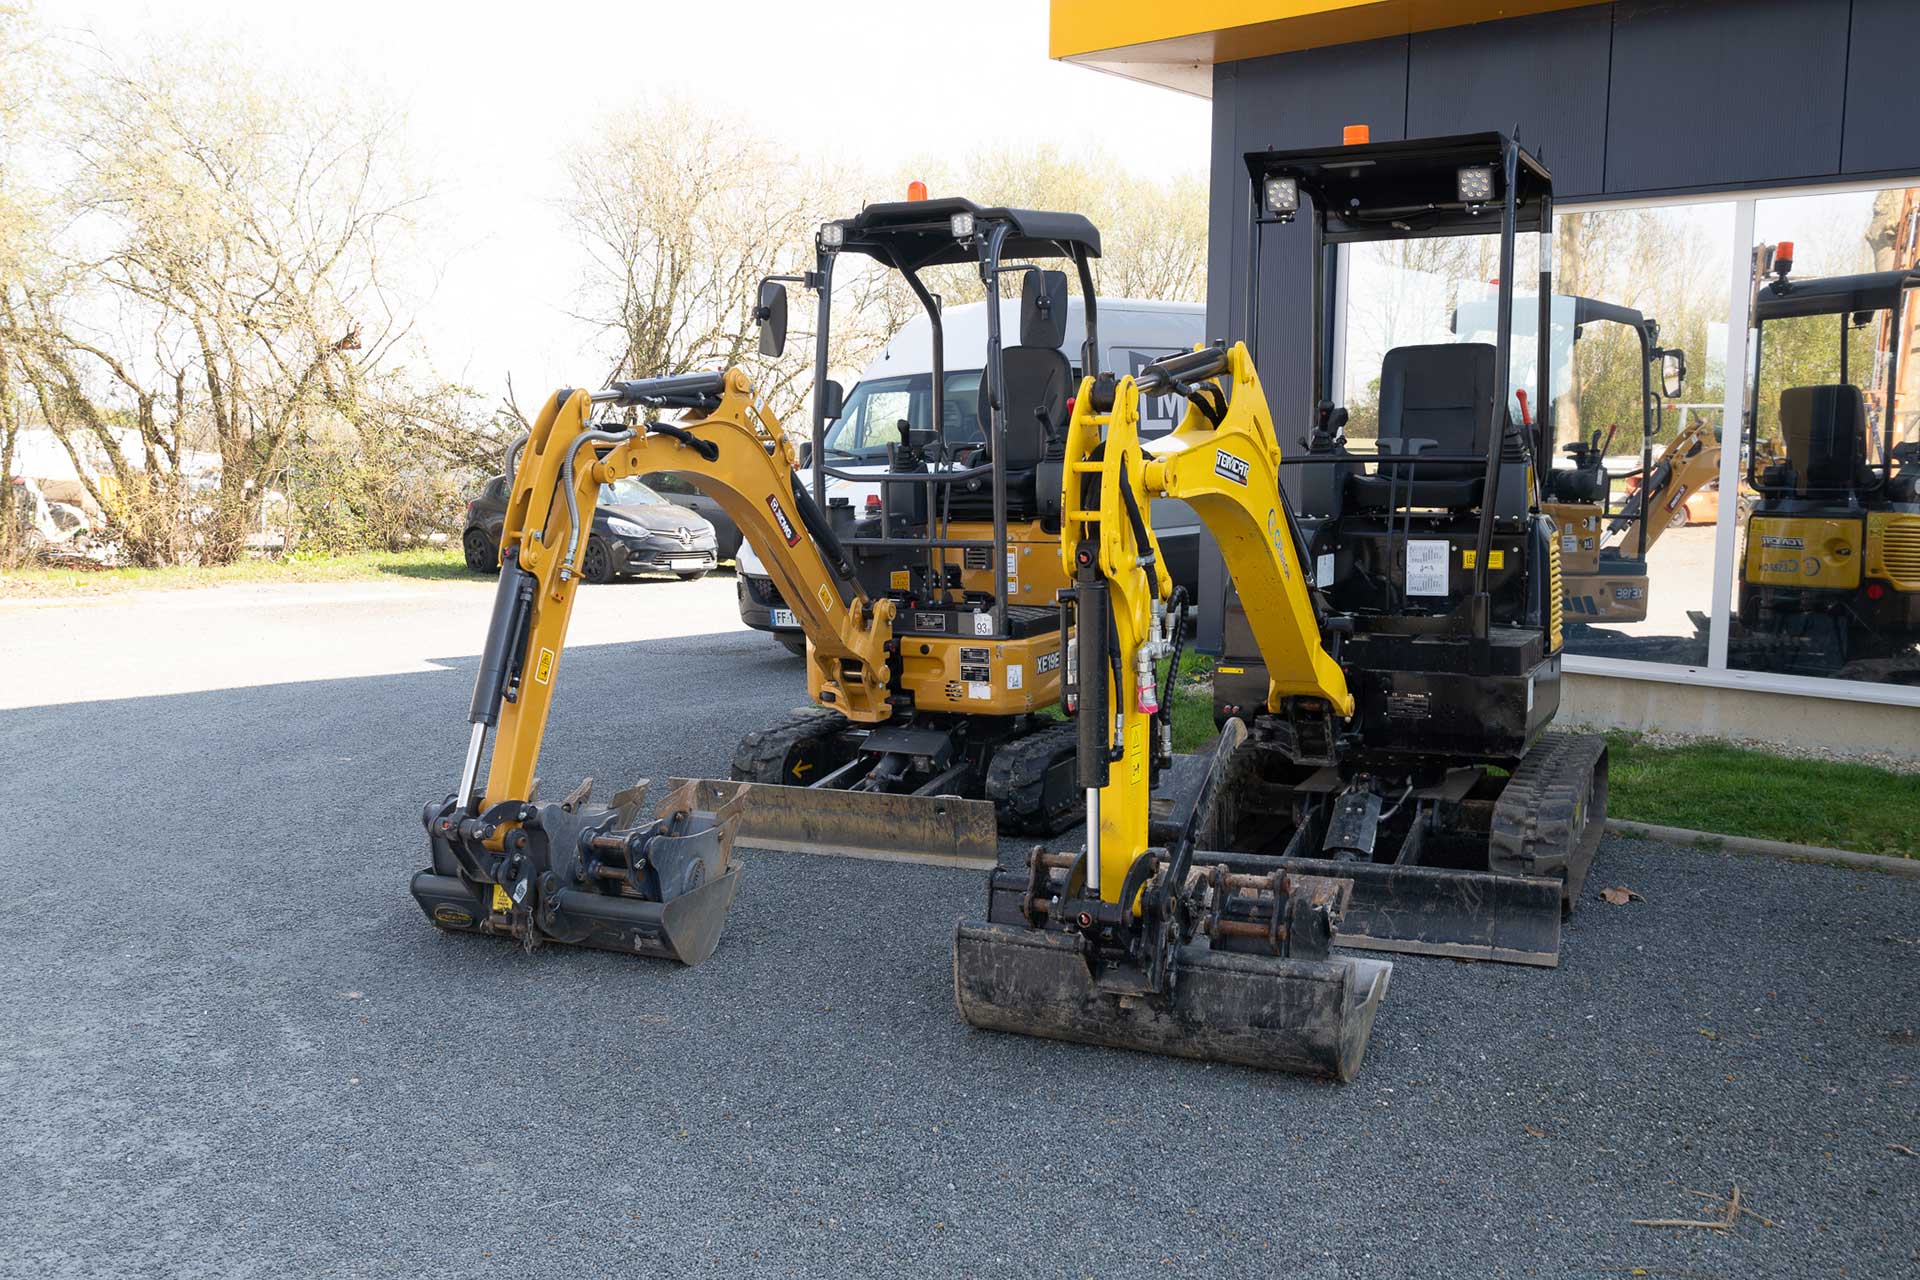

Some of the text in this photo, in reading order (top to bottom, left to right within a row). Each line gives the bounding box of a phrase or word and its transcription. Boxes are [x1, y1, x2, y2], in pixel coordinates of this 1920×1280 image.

[1217, 452, 1249, 477] TOMCAT
[775, 508, 792, 539] XCMG
[776, 611, 801, 624] FF-1
